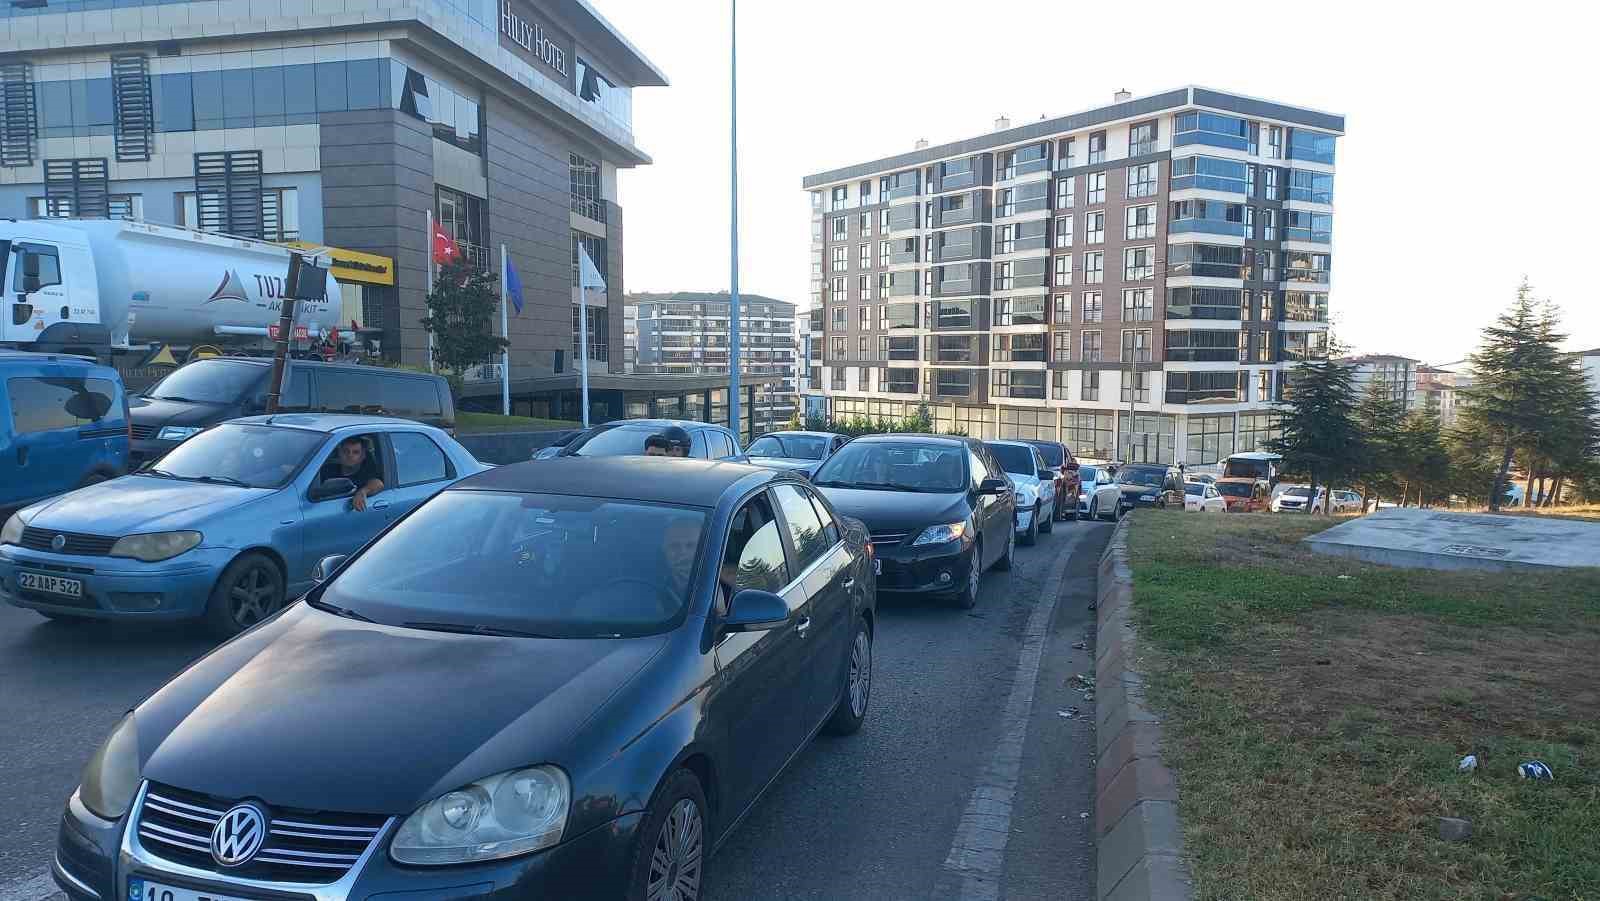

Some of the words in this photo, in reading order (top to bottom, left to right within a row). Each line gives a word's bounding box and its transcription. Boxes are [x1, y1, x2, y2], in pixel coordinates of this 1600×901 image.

[501, 0, 534, 51] HILLY
[535, 23, 568, 78] HOTEL
[22, 574, 36, 588] 22
[60, 580, 80, 594] 522
